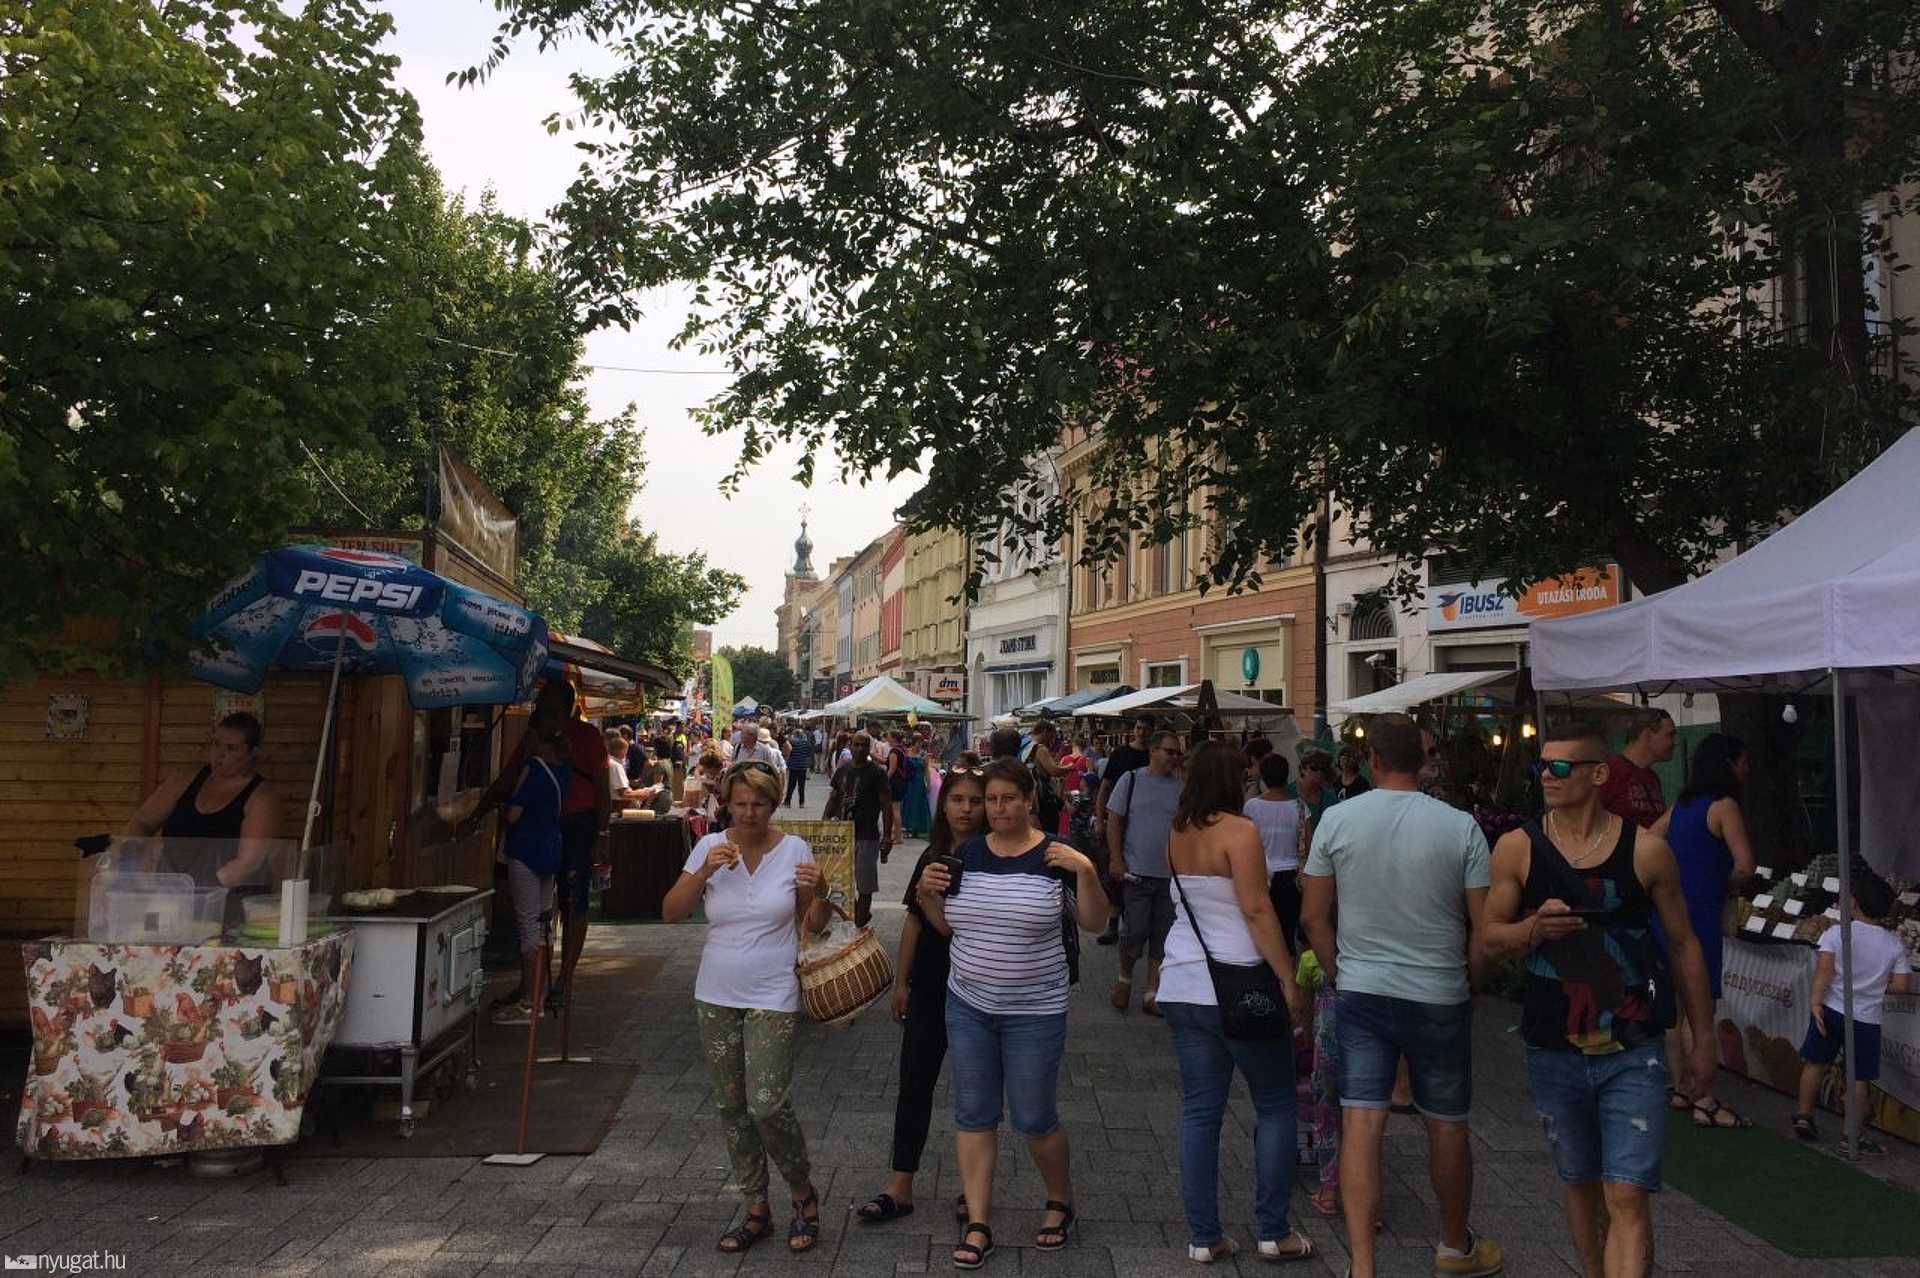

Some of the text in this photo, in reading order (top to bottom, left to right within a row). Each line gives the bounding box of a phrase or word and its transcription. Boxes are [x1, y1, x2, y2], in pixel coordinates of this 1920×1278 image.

[293, 569, 424, 610] PEPSI
[1460, 592, 1504, 614] IBUSZ
[939, 677, 959, 688] dm
